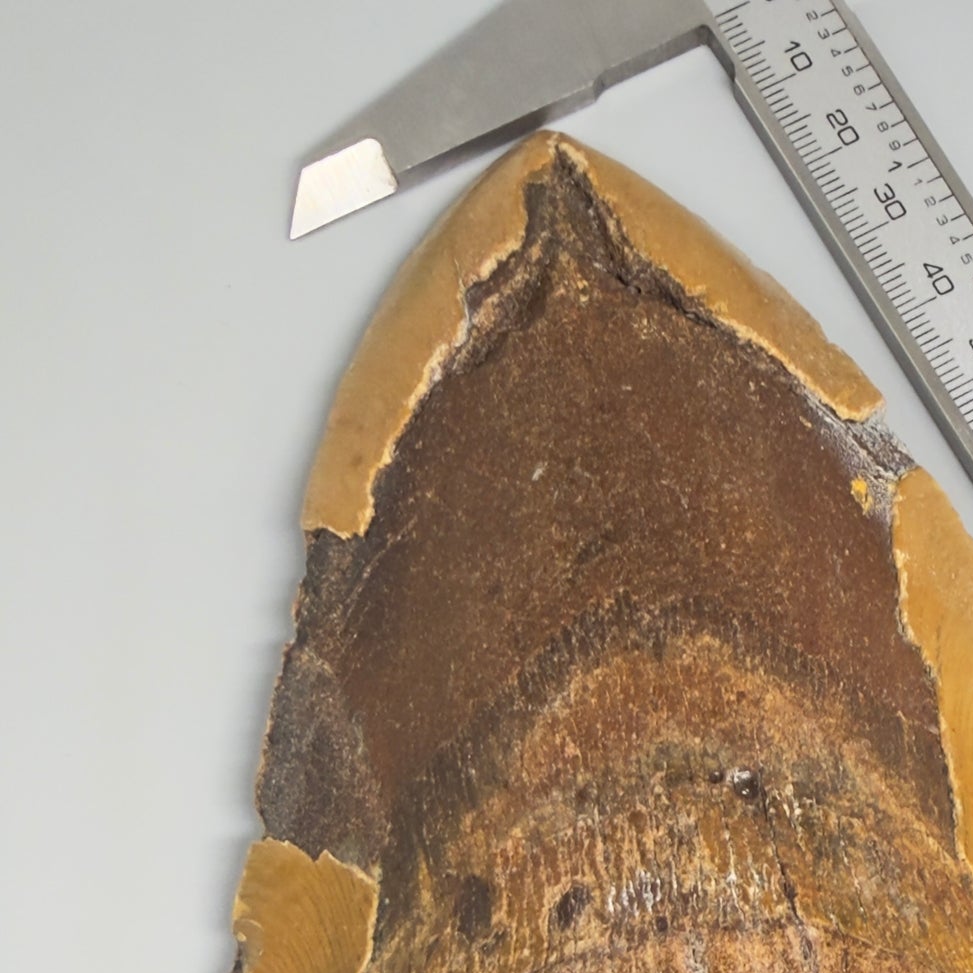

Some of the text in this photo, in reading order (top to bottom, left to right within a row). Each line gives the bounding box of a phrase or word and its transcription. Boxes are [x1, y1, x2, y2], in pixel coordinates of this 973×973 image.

[784, 41, 813, 72] 10
[826, 109, 860, 146] 20
[873, 183, 907, 221] 30
[923, 263, 955, 296] 40
[888, 161, 903, 172] 1
